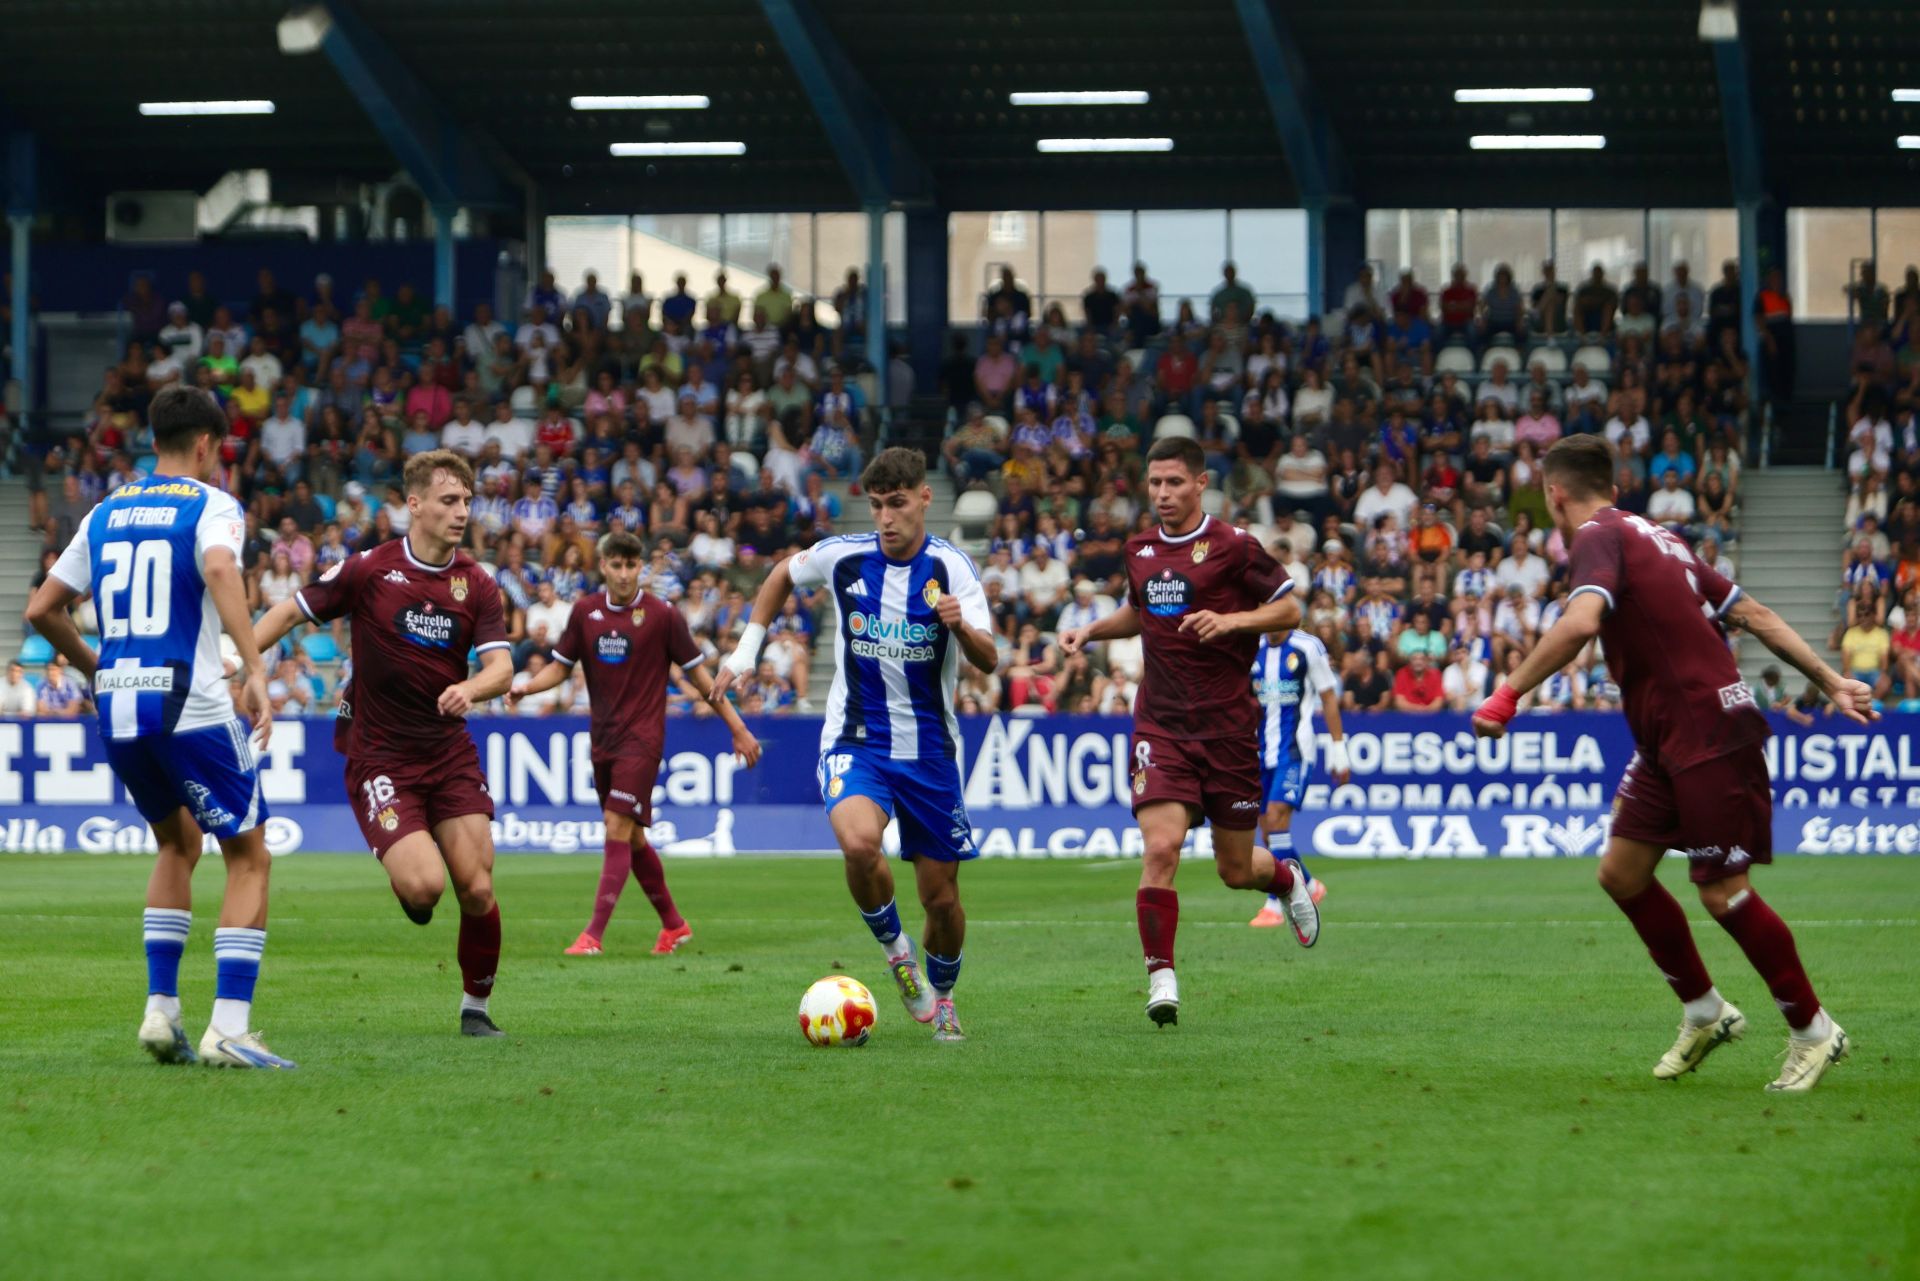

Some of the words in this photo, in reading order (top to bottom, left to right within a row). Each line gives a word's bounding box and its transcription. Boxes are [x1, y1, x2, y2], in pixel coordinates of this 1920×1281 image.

[130, 506, 178, 526] FERRER
[100, 539, 172, 638] 20
[1147, 580, 1185, 592] Estrella
[1148, 591, 1183, 604] Galicia
[405, 610, 452, 628] Estrella
[407, 622, 450, 639] Galicia
[850, 640, 935, 661] CRICURSA
[102, 675, 171, 689] VALCARCE
[826, 753, 853, 779] 18
[363, 775, 395, 811] 16
[1312, 814, 1488, 859] CAJA
[1796, 815, 1920, 855] Estre
